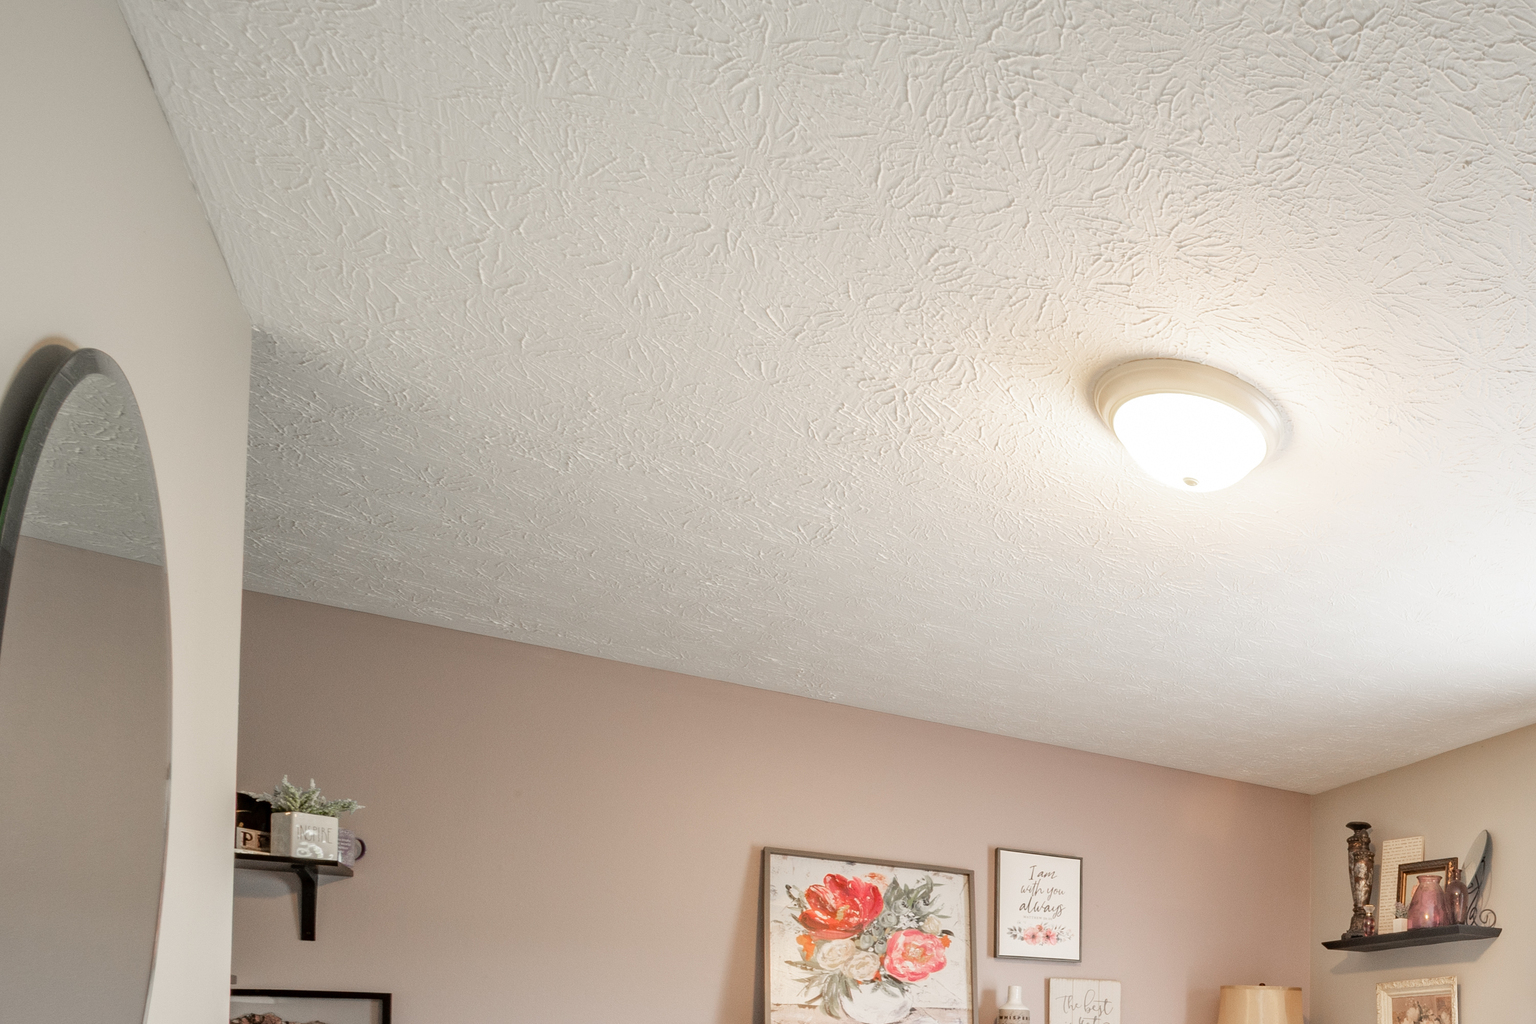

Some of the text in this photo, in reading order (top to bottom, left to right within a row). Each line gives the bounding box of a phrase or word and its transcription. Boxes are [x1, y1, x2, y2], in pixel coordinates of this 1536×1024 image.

[1028, 864, 1058, 881] I am
[1020, 878, 1066, 901] with you
[1019, 896, 1066, 919] always
[1055, 988, 1114, 1018] The best
